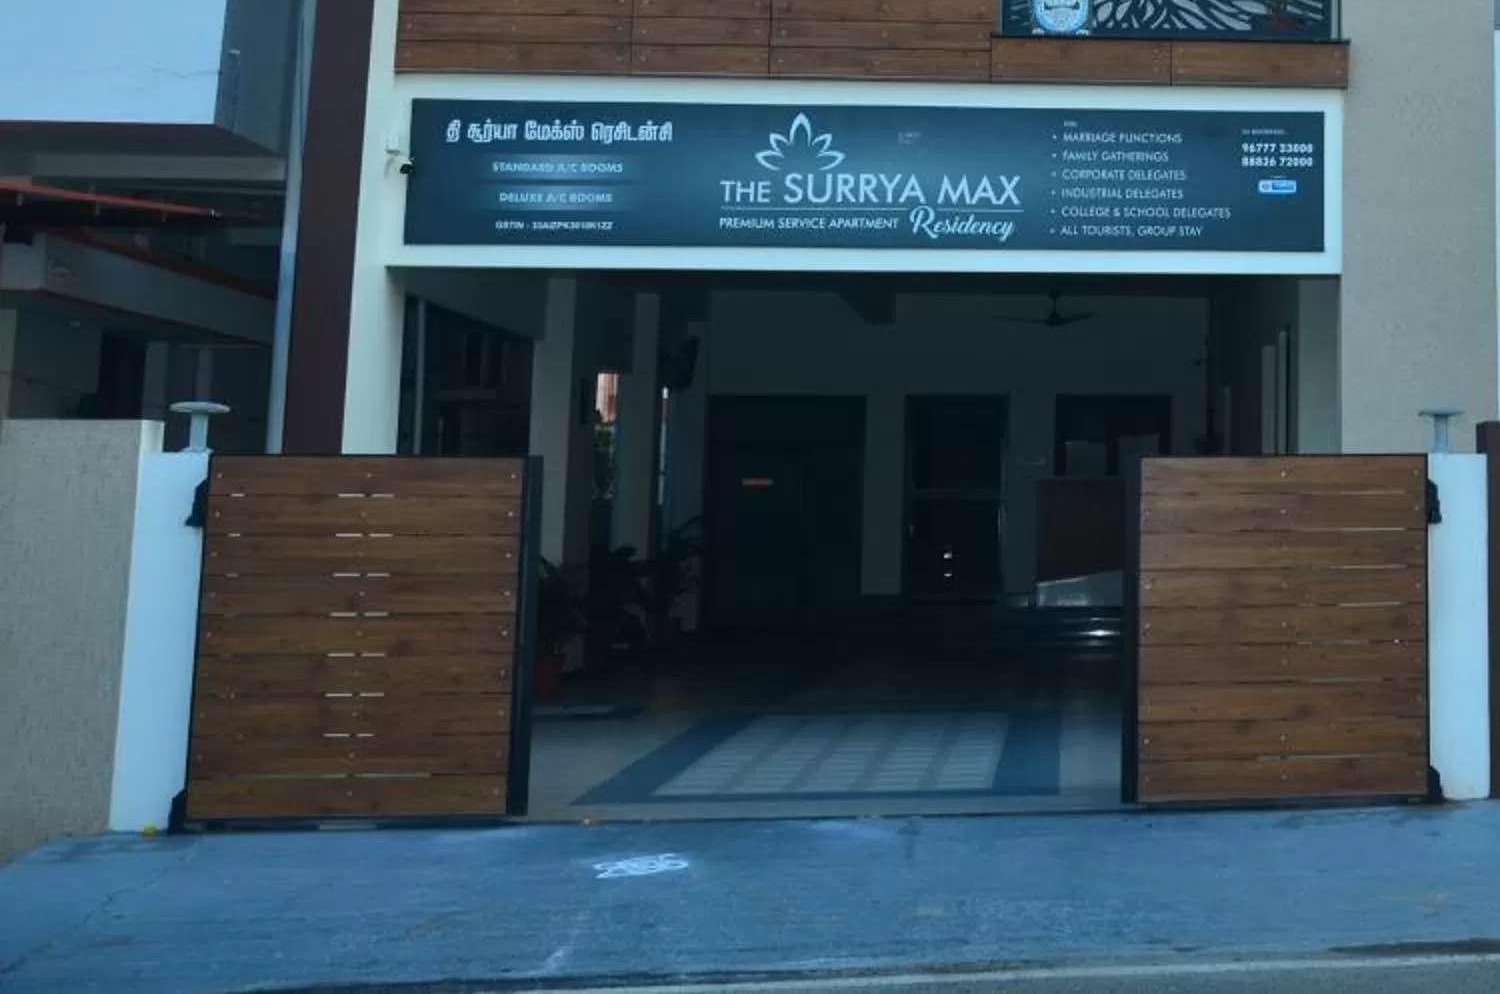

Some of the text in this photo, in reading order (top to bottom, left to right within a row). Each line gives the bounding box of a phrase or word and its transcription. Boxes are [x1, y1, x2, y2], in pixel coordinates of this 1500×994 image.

[446, 119, 461, 142] தி
[467, 118, 518, 142] சூர்யா
[524, 119, 585, 141] மேக்ஸ்
[1062, 132, 1183, 144] MARRIAGE FUNCTIONS
[1062, 150, 1169, 162] FAMILY GATHERINGS
[492, 161, 623, 173] STANDARD A/C ROOMS
[1061, 169, 1187, 181] CORPORATE DELEGATES
[720, 172, 1021, 205] THE SURRYA MAX
[1061, 187, 1184, 200] INDUSTRIAL DELEGATES
[499, 191, 613, 204] DELUXE A/C ROOMS
[1061, 206, 1111, 218] COLLEGE
[1123, 206, 1170, 218] SCHOOL
[1173, 207, 1232, 219] DELEGATES
[719, 216, 899, 230] PREMIUM SERVICE APARTMENT
[909, 205, 1016, 242] Residency
[1060, 225, 1078, 236] ALL
[1137, 225, 1177, 237] GROUP
[1178, 225, 1203, 237] STAY
